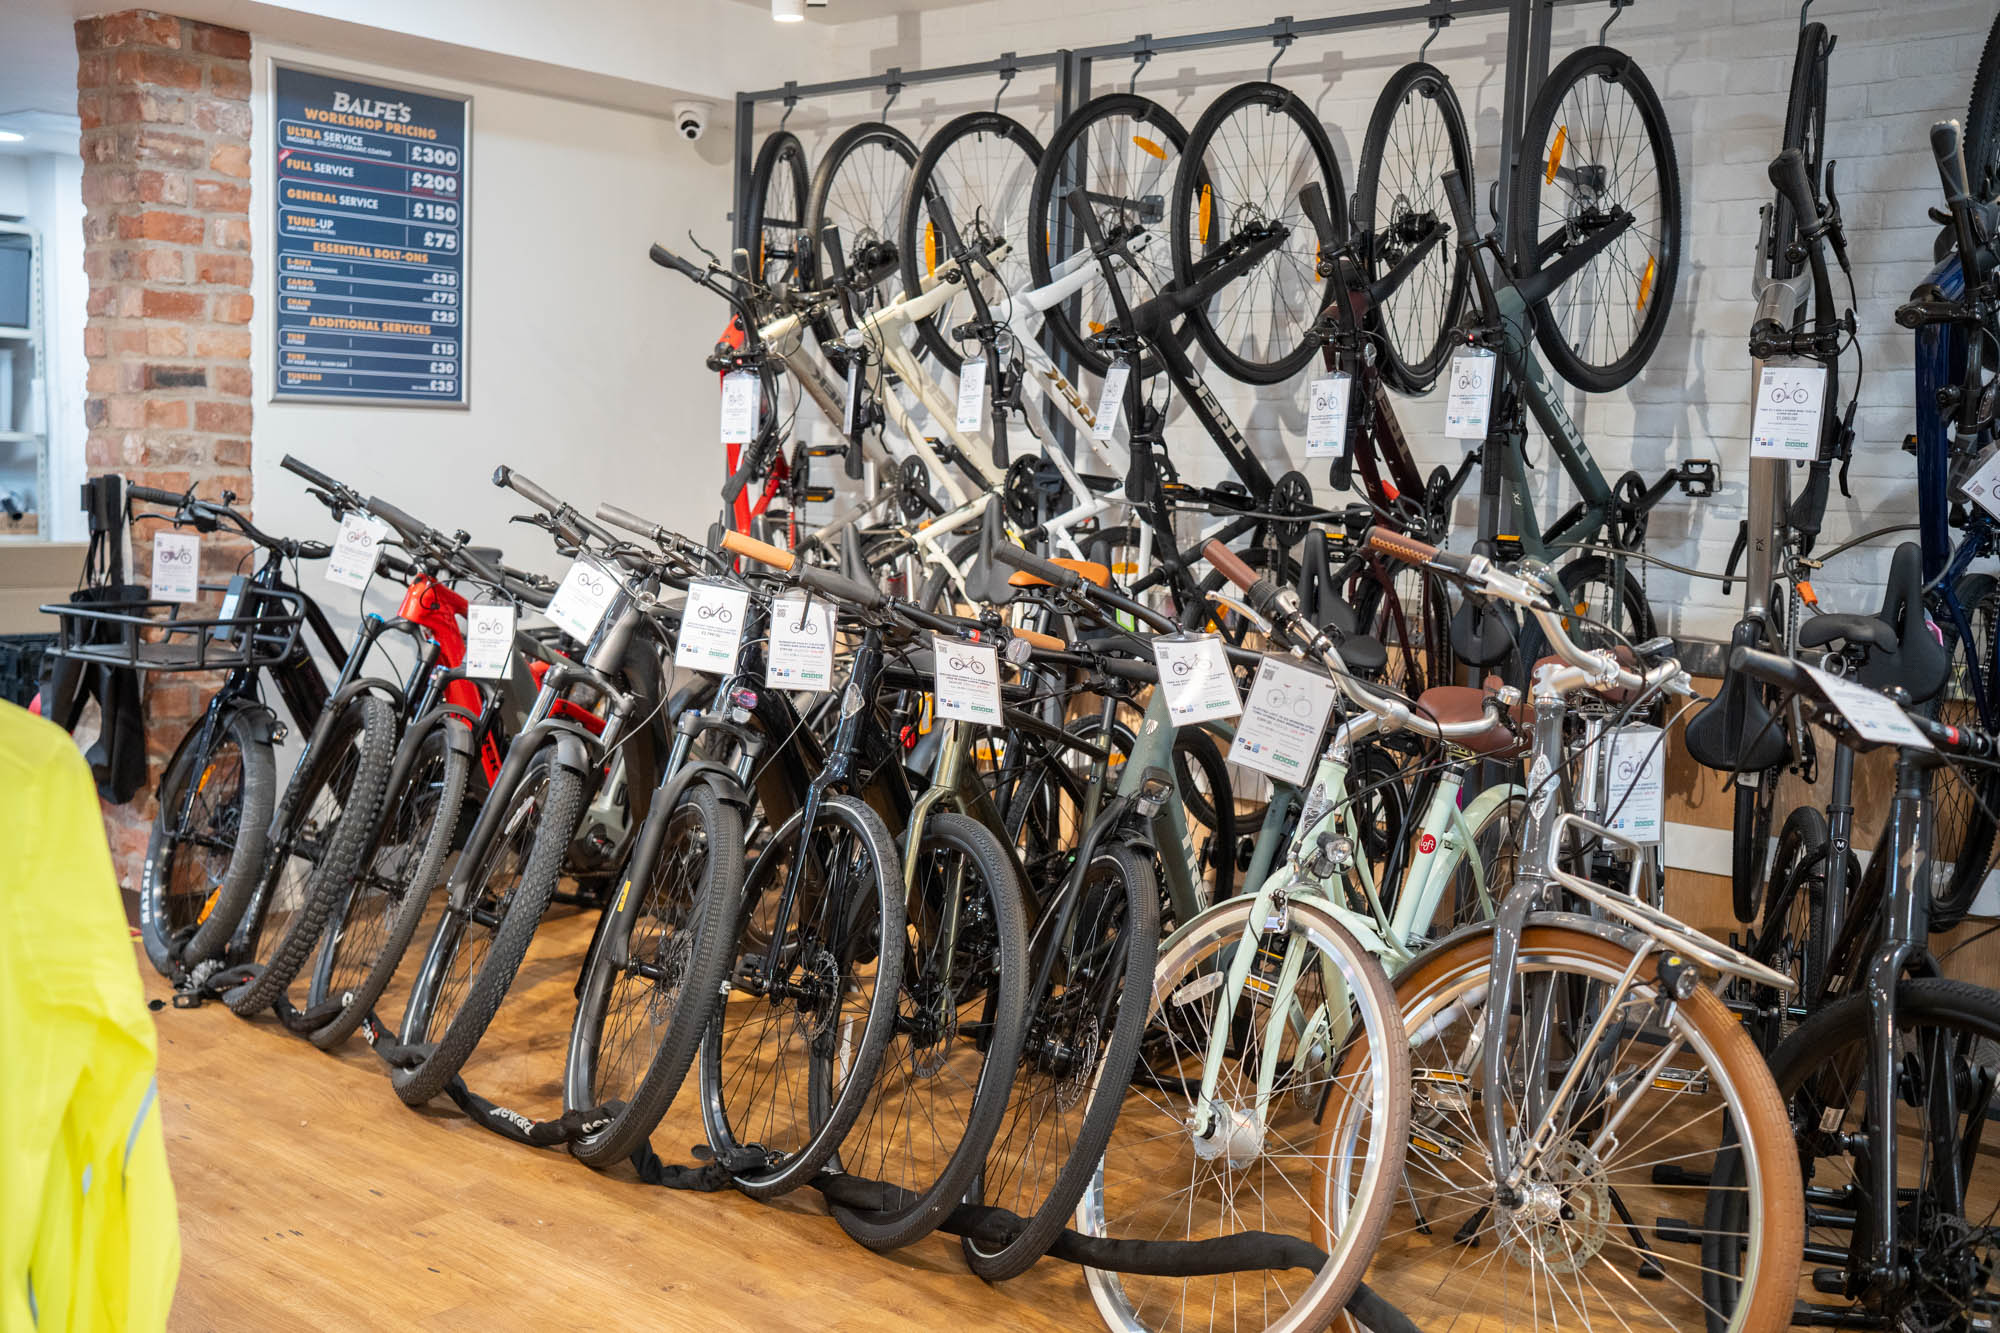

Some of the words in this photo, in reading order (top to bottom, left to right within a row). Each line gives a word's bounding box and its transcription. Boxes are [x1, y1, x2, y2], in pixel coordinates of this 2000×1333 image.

[333, 92, 411, 123] BALFE'S
[304, 108, 383, 131] WORKSHOP
[385, 123, 437, 140] PRICING
[287, 125, 321, 140] ULTRA
[323, 131, 363, 146] SERVICE
[412, 146, 457, 167] £300
[287, 159, 312, 172] FULL
[314, 163, 354, 178] SERVICE
[412, 172, 457, 192] £200
[287, 189, 337, 204] GENERAL
[339, 195, 378, 209] SERVICE
[413, 203, 457, 222] £150
[287, 215, 334, 230] TUNE-UP
[423, 232, 456, 249] £75
[313, 242, 372, 258] ESSENTIAL
[374, 248, 428, 263] BOLT-ONS
[432, 273, 456, 286] £35
[432, 292, 456, 305] £75
[309, 317, 380, 331] ADDITIONAL
[382, 322, 431, 335] SERVICES
[432, 311, 456, 323] £25
[432, 343, 455, 355] £15
[430, 362, 454, 374] £30
[430, 380, 454, 392] £35
[811, 368, 846, 415] REK
[1184, 369, 1246, 460] TREK
[1535, 373, 1592, 472] TREK
[1512, 492, 1522, 506] FX
[1755, 537, 1764, 552] FX
[1181, 822, 1208, 912] TRE
